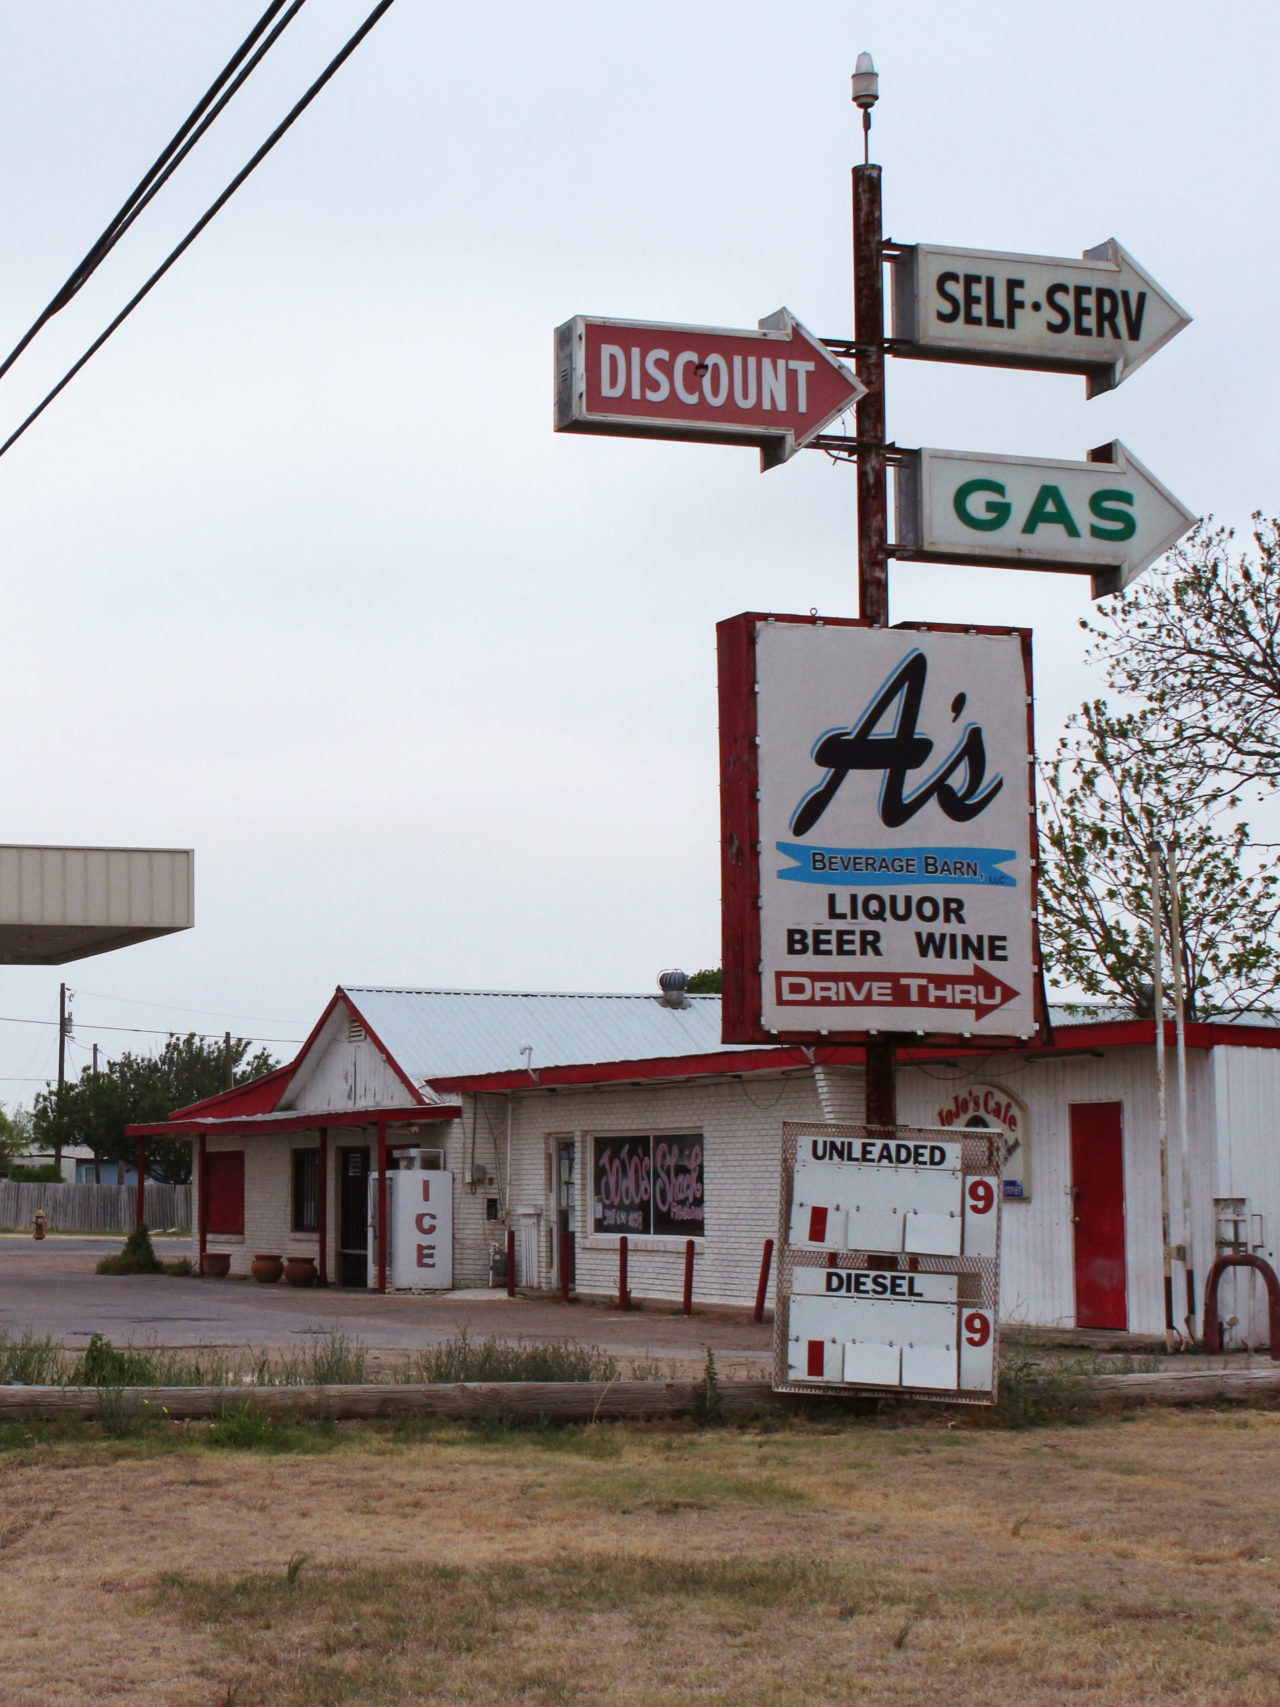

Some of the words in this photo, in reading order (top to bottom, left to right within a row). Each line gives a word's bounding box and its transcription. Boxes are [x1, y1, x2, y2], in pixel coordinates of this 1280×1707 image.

[599, 343, 816, 414] DISCOUNT
[952, 478, 1138, 542] GAS
[789, 646, 1004, 837] A's
[811, 852, 917, 874] BEVERAGE
[988, 875, 1006, 886] LLC
[827, 893, 967, 925] LIQUOR
[786, 928, 883, 957] BEER
[914, 931, 1008, 962] WINE
[780, 976, 893, 1002] DRIVE
[899, 977, 1002, 1005] THRU
[811, 1139, 947, 1167] UNLEADED
[968, 1179, 995, 1215] 9
[414, 1179, 438, 1269] ICE
[825, 1271, 924, 1298] DIESEL
[964, 1312, 991, 1348] 9
